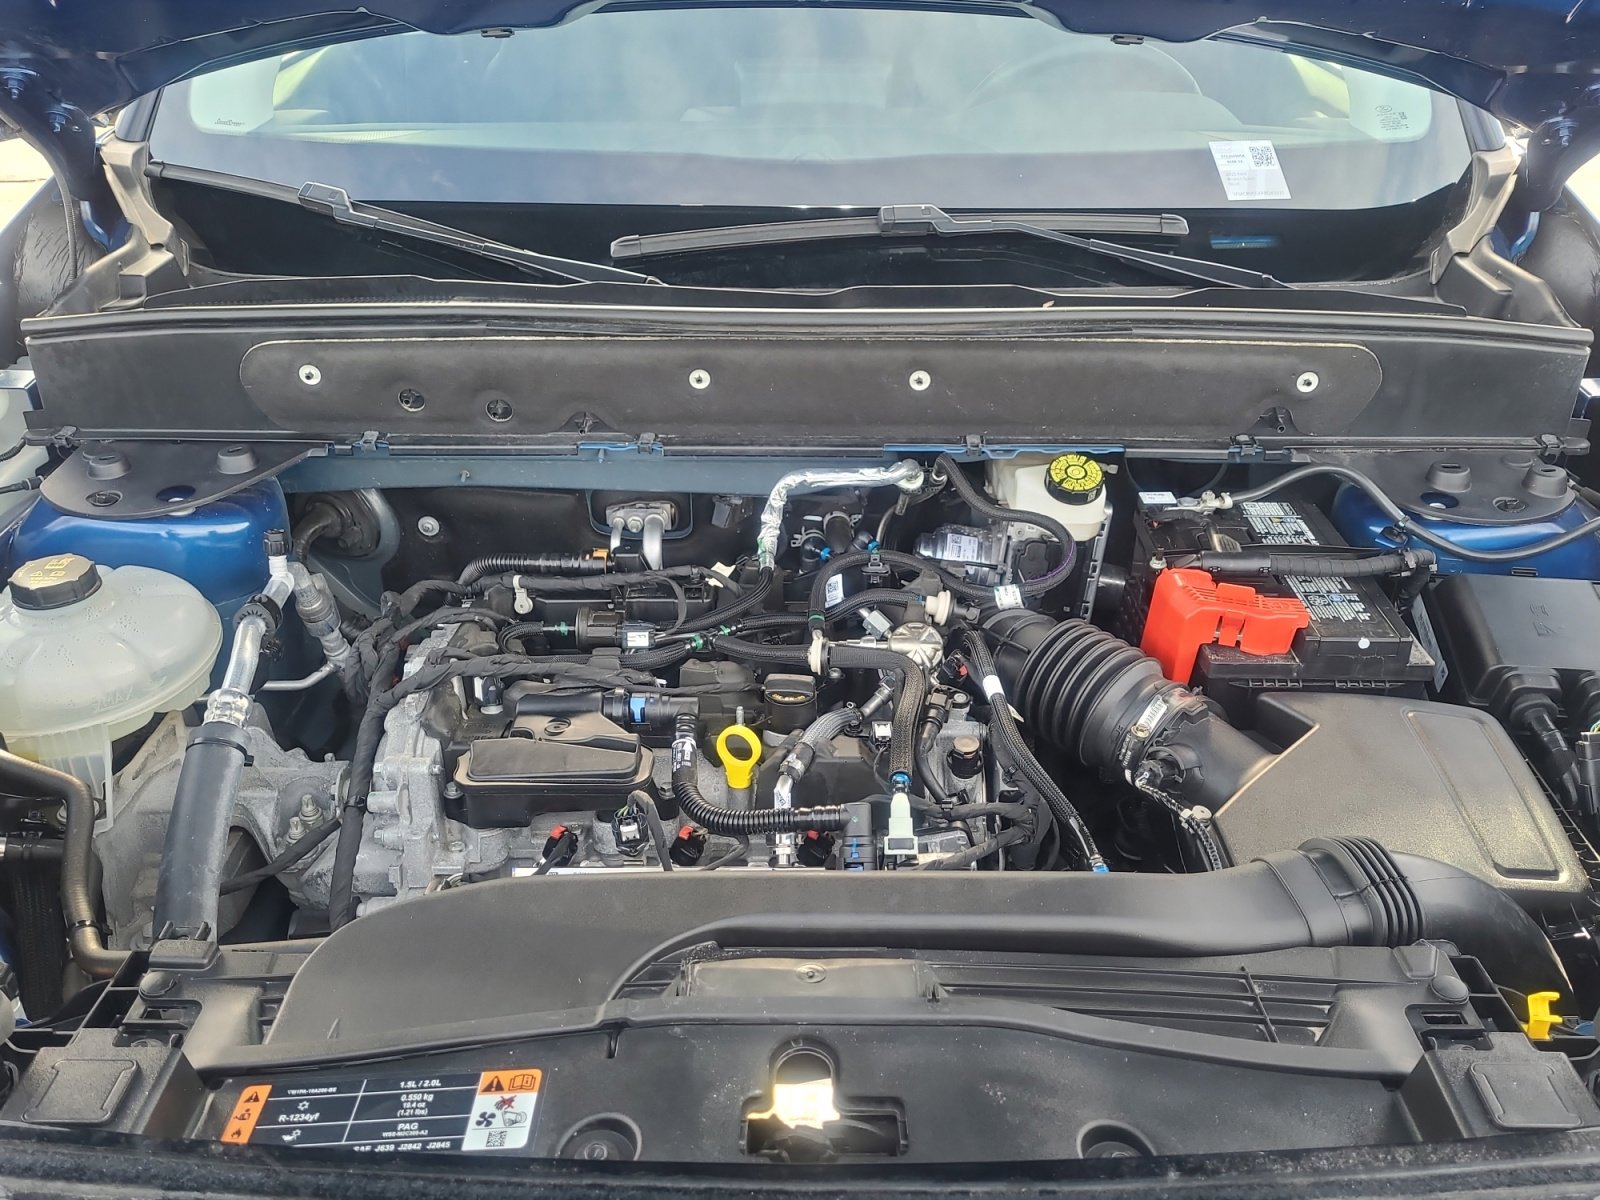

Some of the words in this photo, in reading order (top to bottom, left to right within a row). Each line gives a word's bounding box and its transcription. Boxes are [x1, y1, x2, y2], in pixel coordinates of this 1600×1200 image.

[423, 1079, 441, 1087] 2.0L
[400, 1094, 422, 1102] 0.550
[423, 1093, 434, 1102] kg
[397, 1109, 414, 1117] (1.21
[415, 1108, 428, 1116] lbs)
[278, 1112, 320, 1123] R-1234yf
[397, 1122, 419, 1131] PAG
[426, 1141, 451, 1150] J2845
